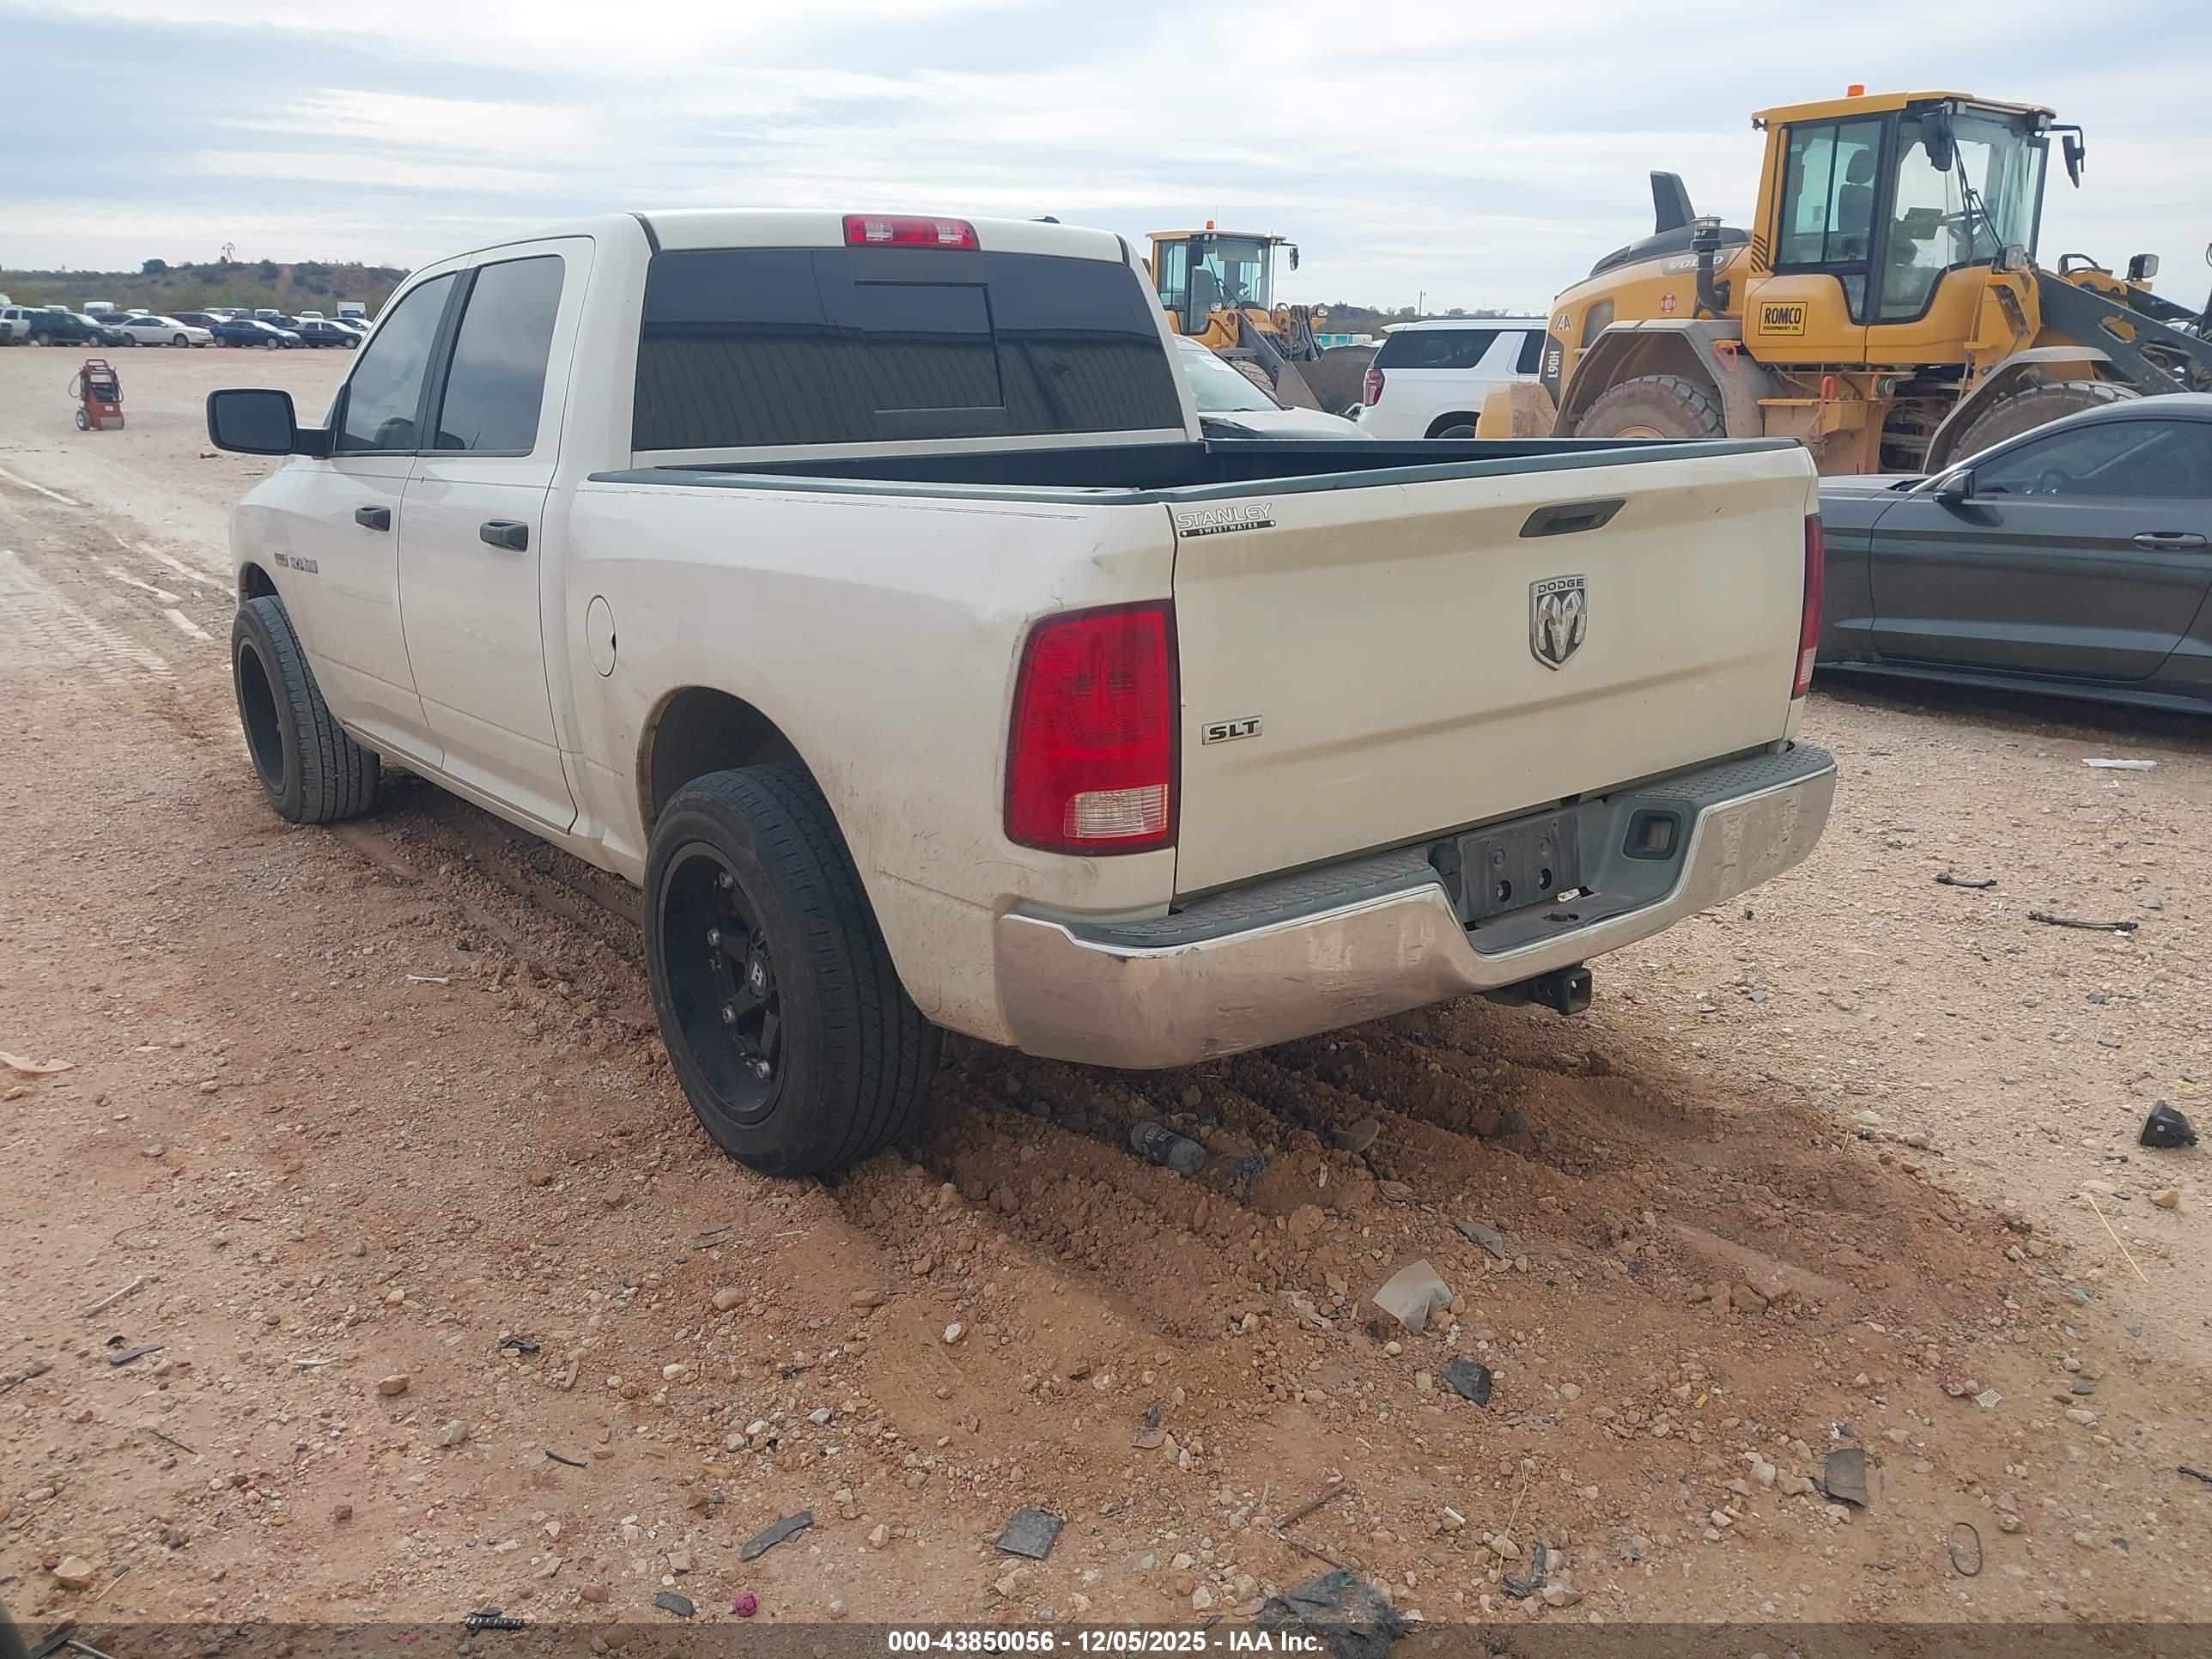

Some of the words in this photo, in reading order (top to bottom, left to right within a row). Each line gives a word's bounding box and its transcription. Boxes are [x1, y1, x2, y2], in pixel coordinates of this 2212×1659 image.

[1669, 256, 1723, 270] VOLO
[1765, 307, 1802, 324] ROMCO
[1547, 350, 1560, 379] L90H
[1176, 502, 1272, 529] STANLEY
[1199, 522, 1259, 535] SWEETWATER
[1538, 578, 1584, 593] DODGE
[1208, 720, 1260, 741] SLT
